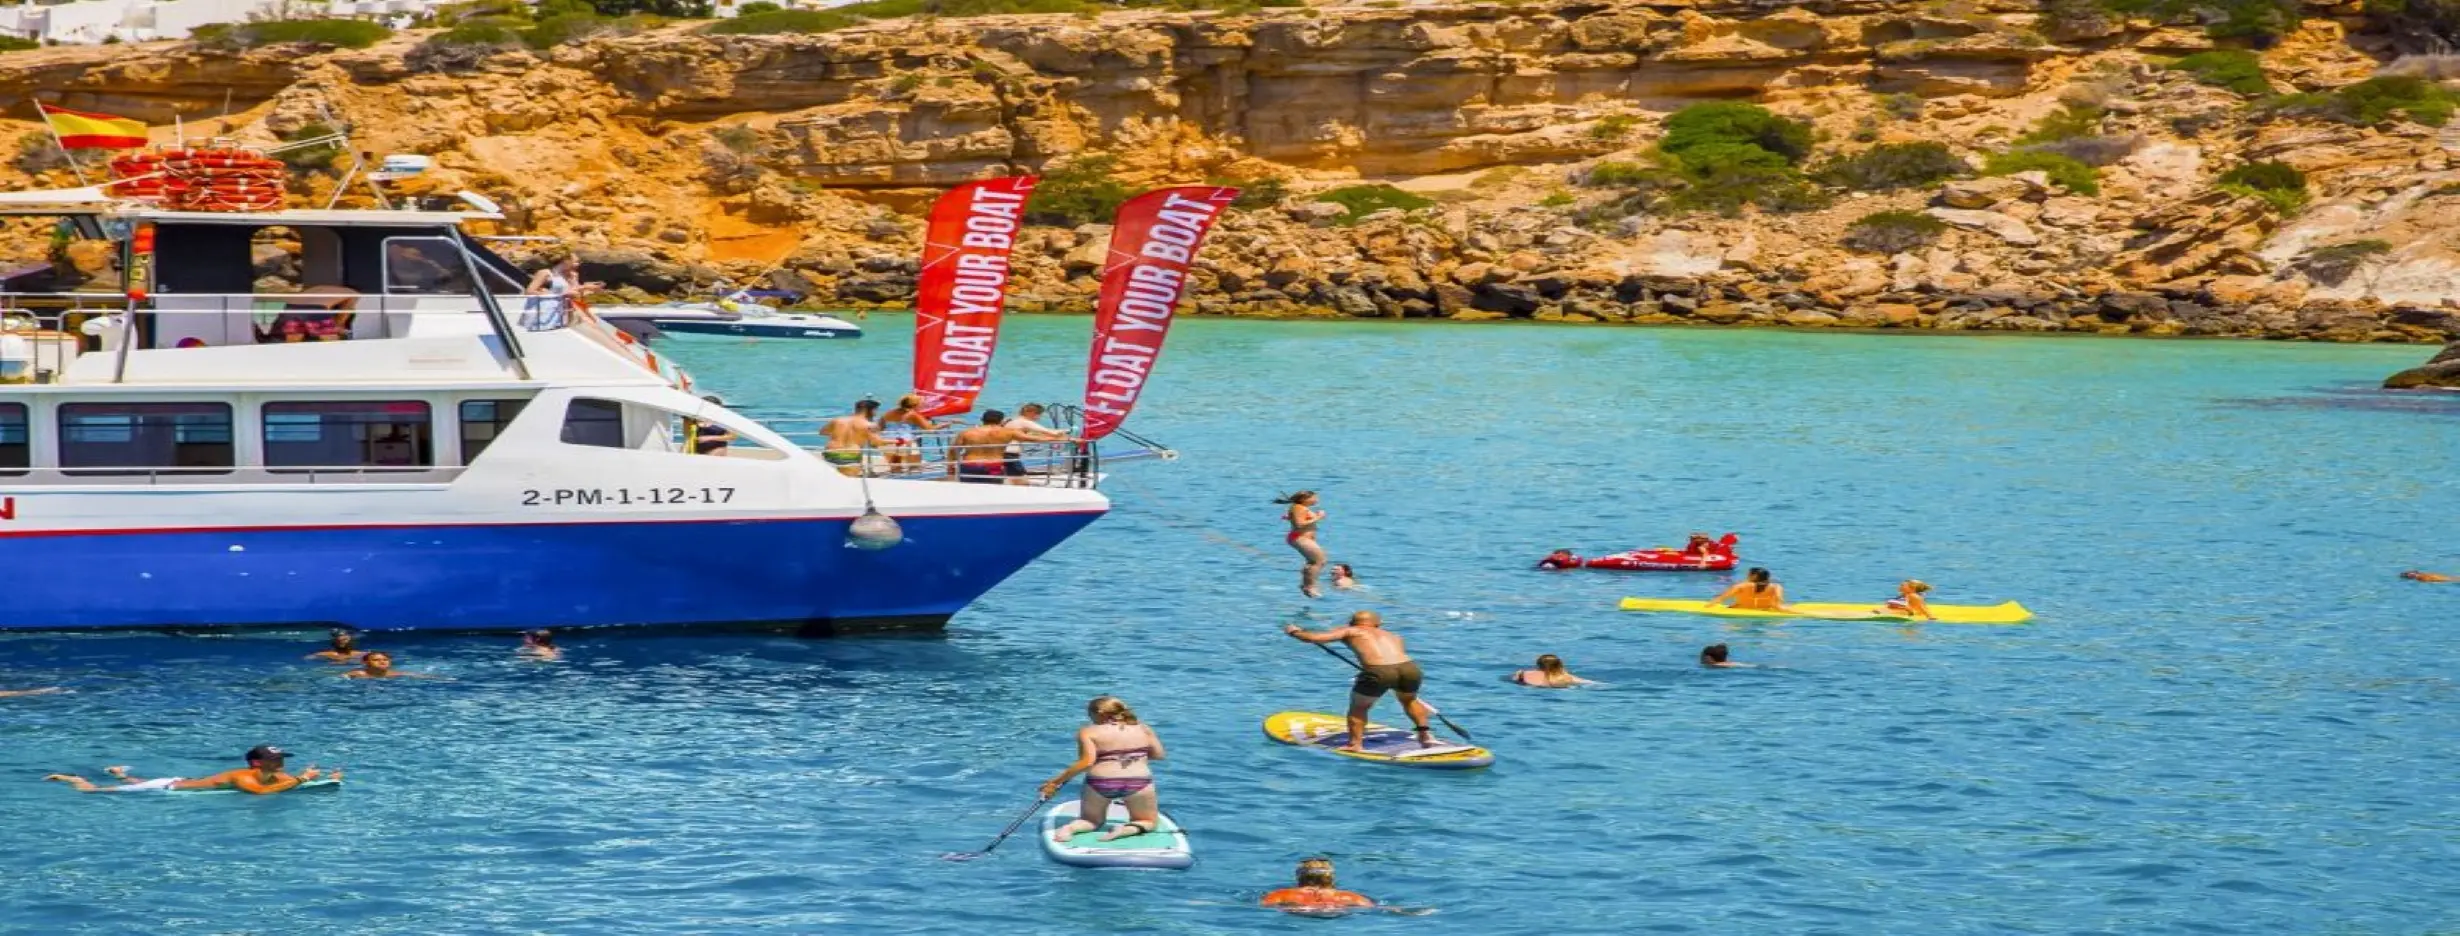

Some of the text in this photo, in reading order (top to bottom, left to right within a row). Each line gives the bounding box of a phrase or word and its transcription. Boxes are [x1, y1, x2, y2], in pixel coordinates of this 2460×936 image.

[934, 186, 1026, 392] FLOAT YOUR BOAT
[1086, 193, 1217, 416] FLOAT YOUR BOAT
[521, 487, 735, 506] 2-PM-1-12-17
